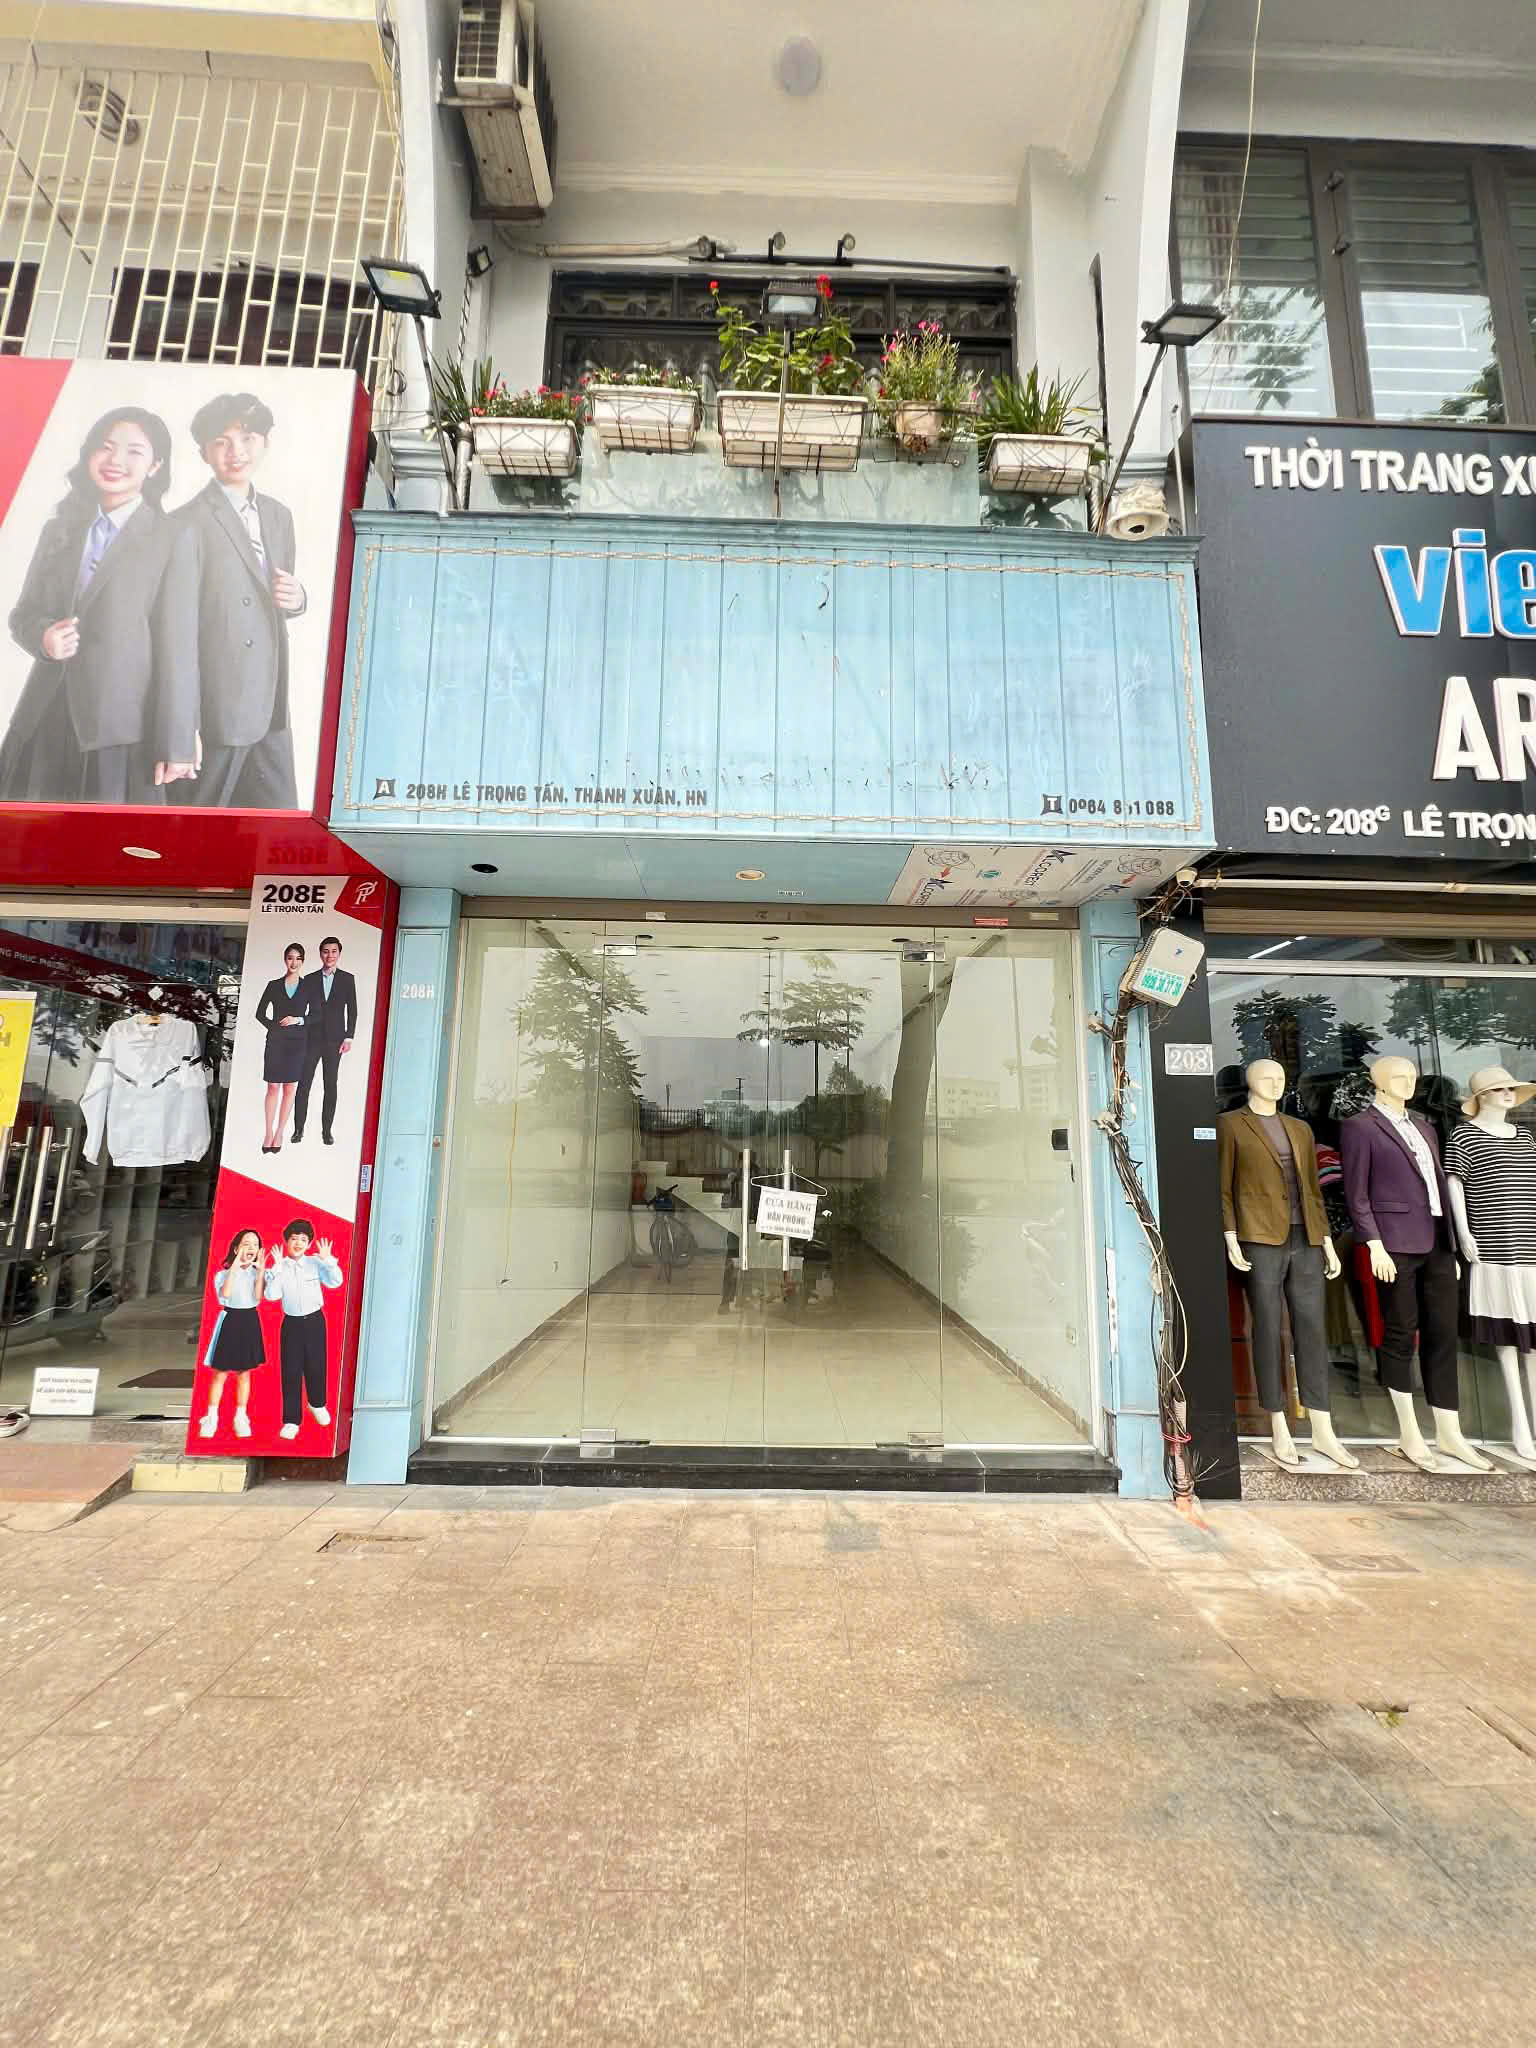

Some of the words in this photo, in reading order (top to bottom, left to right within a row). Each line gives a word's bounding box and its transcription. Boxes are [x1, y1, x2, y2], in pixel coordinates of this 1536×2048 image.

[1245, 437, 1344, 490] THỜI
[1351, 450, 1494, 496] TRANG
[406, 783, 447, 801] 208H
[453, 780, 470, 801] LÊ
[476, 783, 527, 804] TRỌNG
[685, 790, 707, 806] HN
[1403, 803, 1445, 838] LÊ
[1448, 811, 1536, 847] TRỌN
[263, 884, 326, 903] 208E
[261, 904, 272, 913] LÊ
